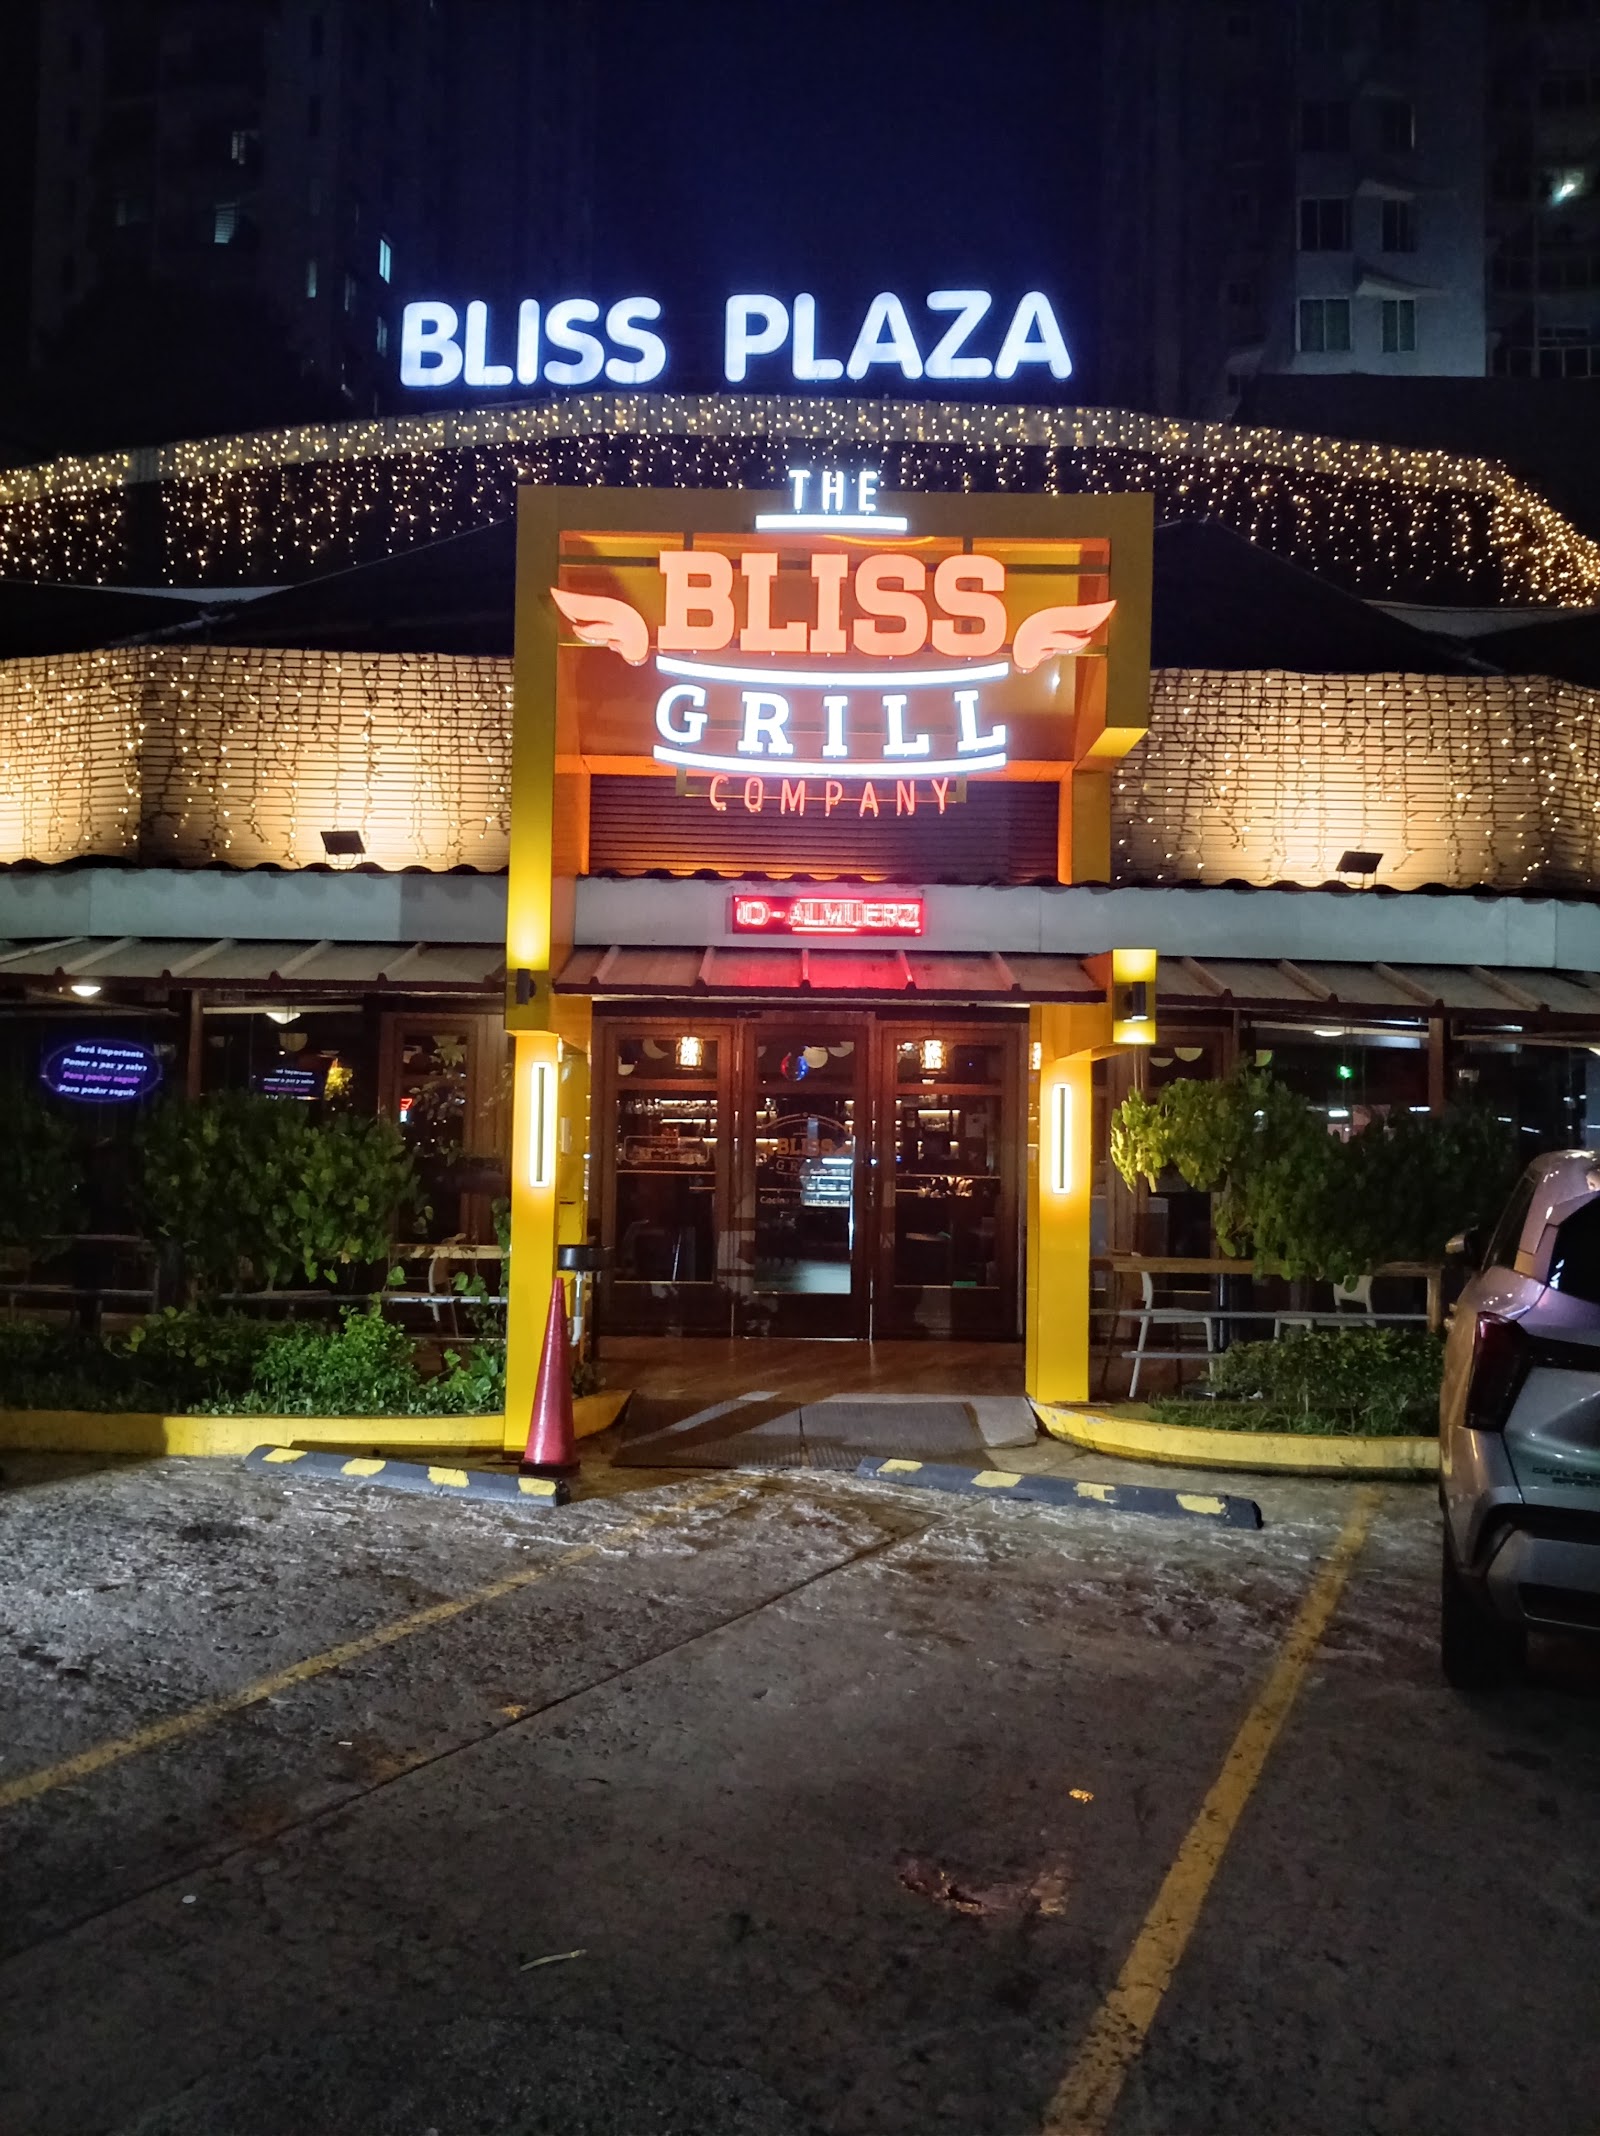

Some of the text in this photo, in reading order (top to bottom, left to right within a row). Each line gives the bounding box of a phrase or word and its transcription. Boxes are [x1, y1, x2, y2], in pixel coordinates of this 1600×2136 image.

[400, 290, 1074, 387] BLISS PLAZA
[788, 470, 878, 513] THE
[657, 550, 1008, 657] BLISS
[655, 683, 1007, 758] GRILL
[709, 774, 950, 817] COMPANY
